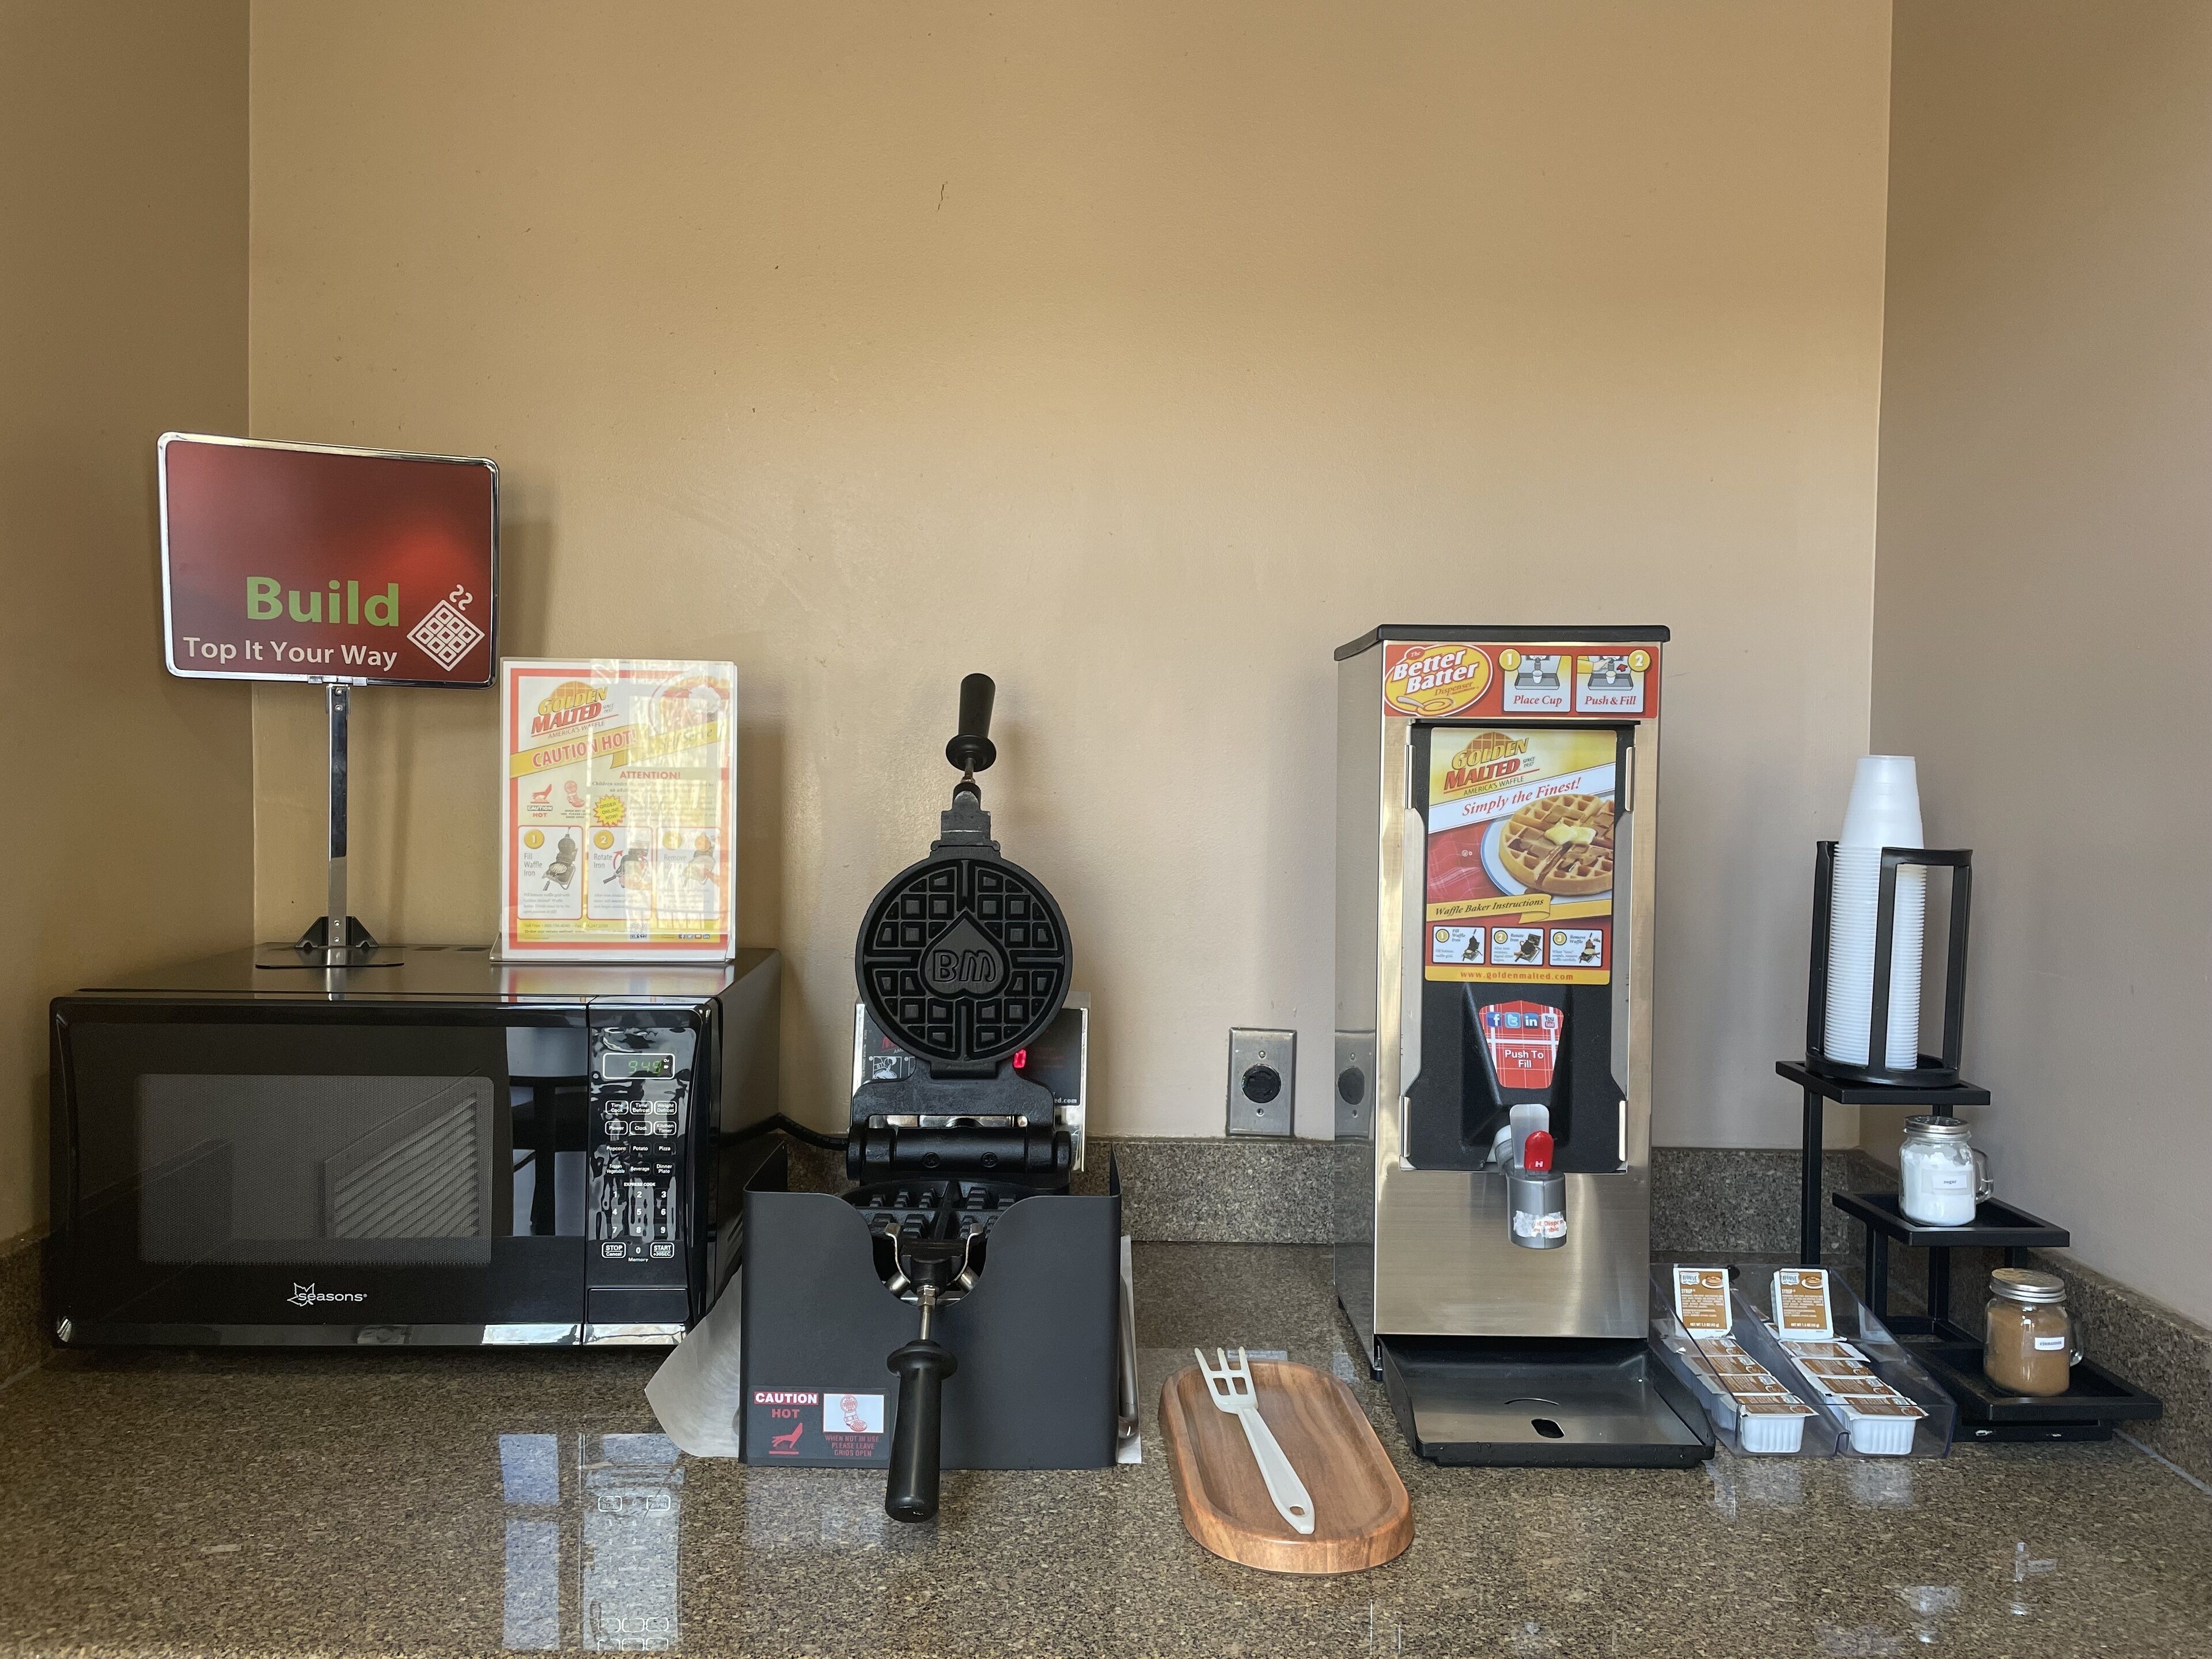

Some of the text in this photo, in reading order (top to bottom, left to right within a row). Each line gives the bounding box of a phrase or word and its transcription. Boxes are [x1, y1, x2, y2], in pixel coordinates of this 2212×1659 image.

[246, 577, 399, 627] Build
[183, 637, 397, 672] Top It Your Way
[1507, 653, 1513, 665] 1
[1635, 654, 1643, 666] 2
[1392, 649, 1467, 681] Better
[1406, 662, 1479, 694] Batter
[1434, 682, 1474, 696] Dispenser
[538, 686, 608, 715] GOLDEN
[1513, 695, 1562, 707] Place Cup
[1585, 696, 1608, 705] Push
[1620, 696, 1637, 705] Fill
[531, 702, 602, 734] MALTED
[548, 727, 580, 739] AMERICA'S
[533, 730, 637, 767] CAUTION HOT!
[1452, 737, 1529, 770] GOLDEN
[620, 771, 681, 779] ATTENTION!
[1444, 758, 1521, 790] MALTED
[1464, 776, 1524, 796] AMERICA'S WAFFLE
[1462, 777, 1582, 816] Simply the Finest!
[532, 835, 537, 844] 1
[600, 836, 607, 844] 2
[1435, 898, 1544, 916] Waffle Baker Instructions
[933, 949, 997, 982] BM
[1460, 971, 1574, 980] www.goldenmalted.com
[1525, 1016, 1538, 1027] in
[1505, 1050, 1544, 1059] Push To
[1518, 1059, 1532, 1069] Fill
[298, 1293, 363, 1301] seasons
[755, 1393, 817, 1404] CAUTION
[771, 1408, 800, 1419] HOT
